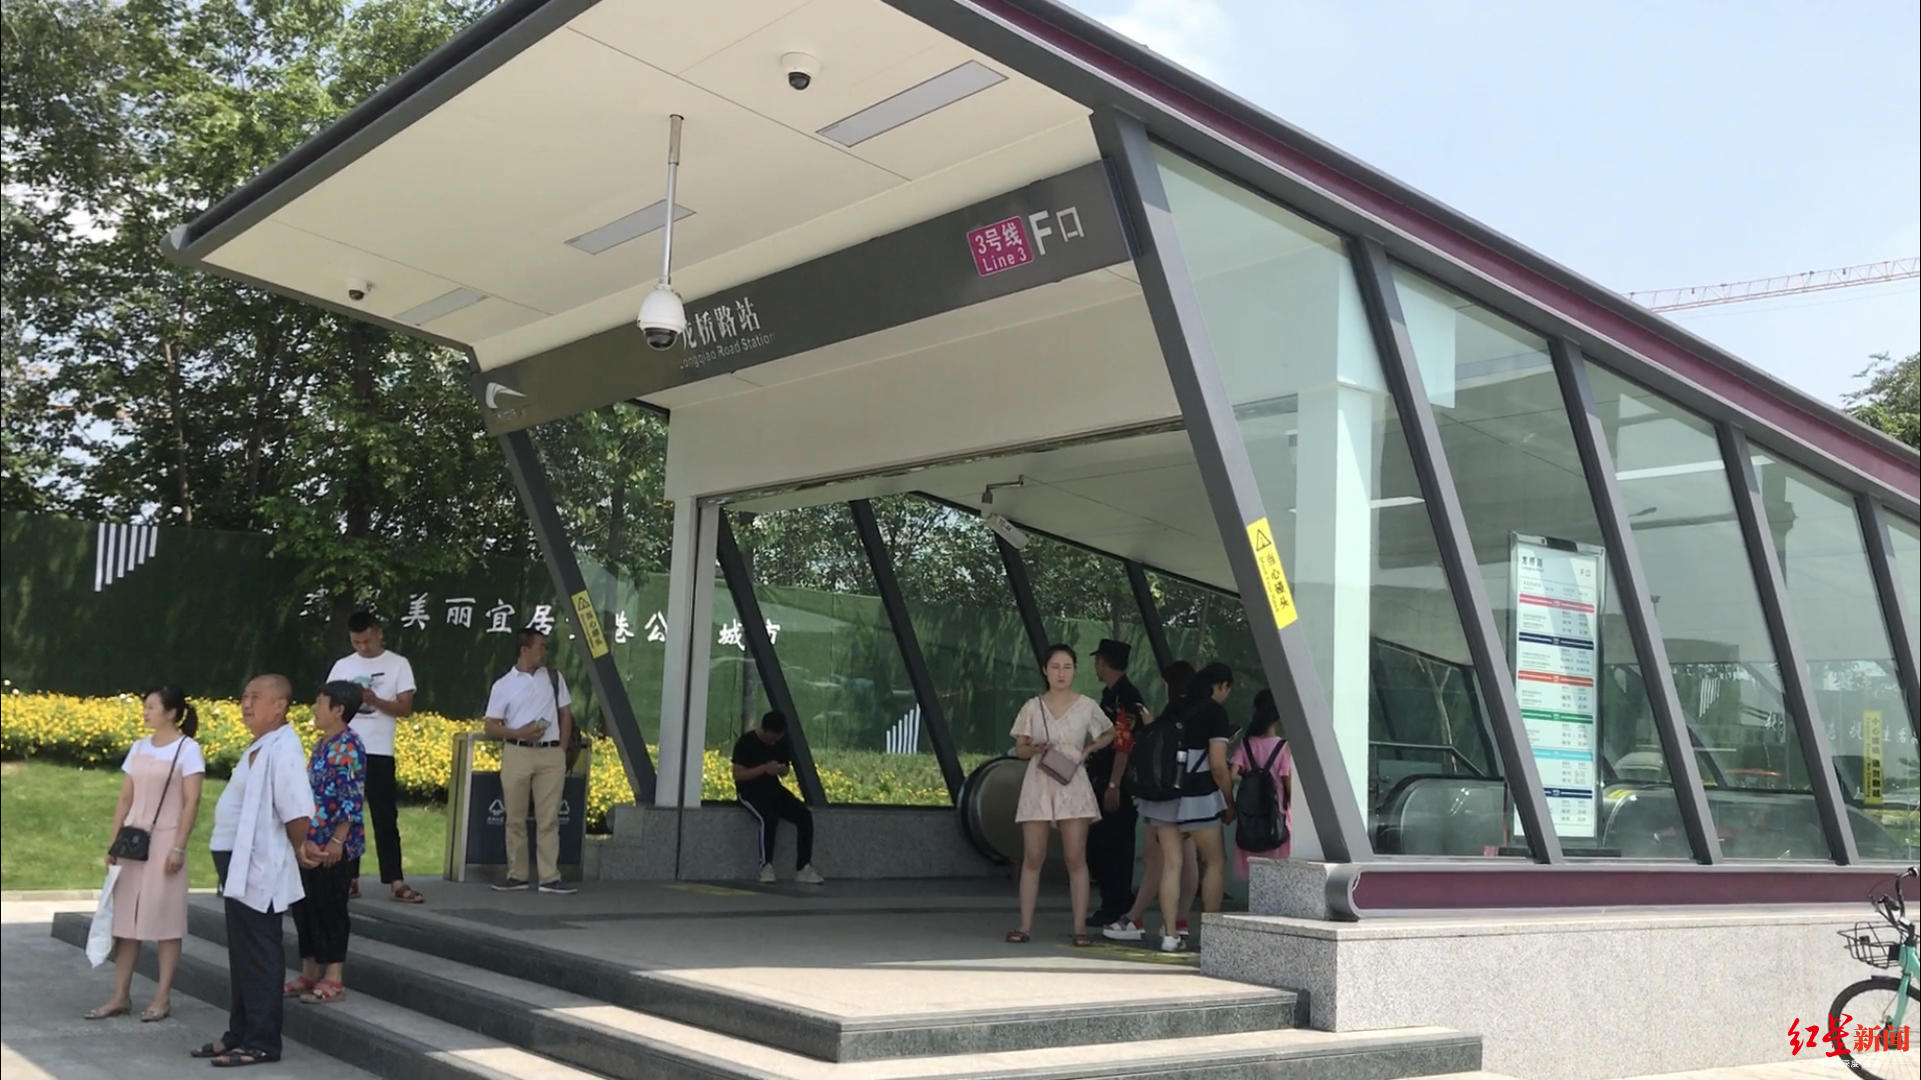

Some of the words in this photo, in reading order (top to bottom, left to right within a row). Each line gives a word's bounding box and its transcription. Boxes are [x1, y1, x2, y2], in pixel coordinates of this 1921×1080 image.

[975, 222, 1023, 254] 3号线
[982, 254, 1015, 272] Line
[1018, 247, 1027, 262] 3
[680, 350, 717, 369] ongqiao
[717, 341, 741, 358] Road
[741, 332, 776, 351] Station
